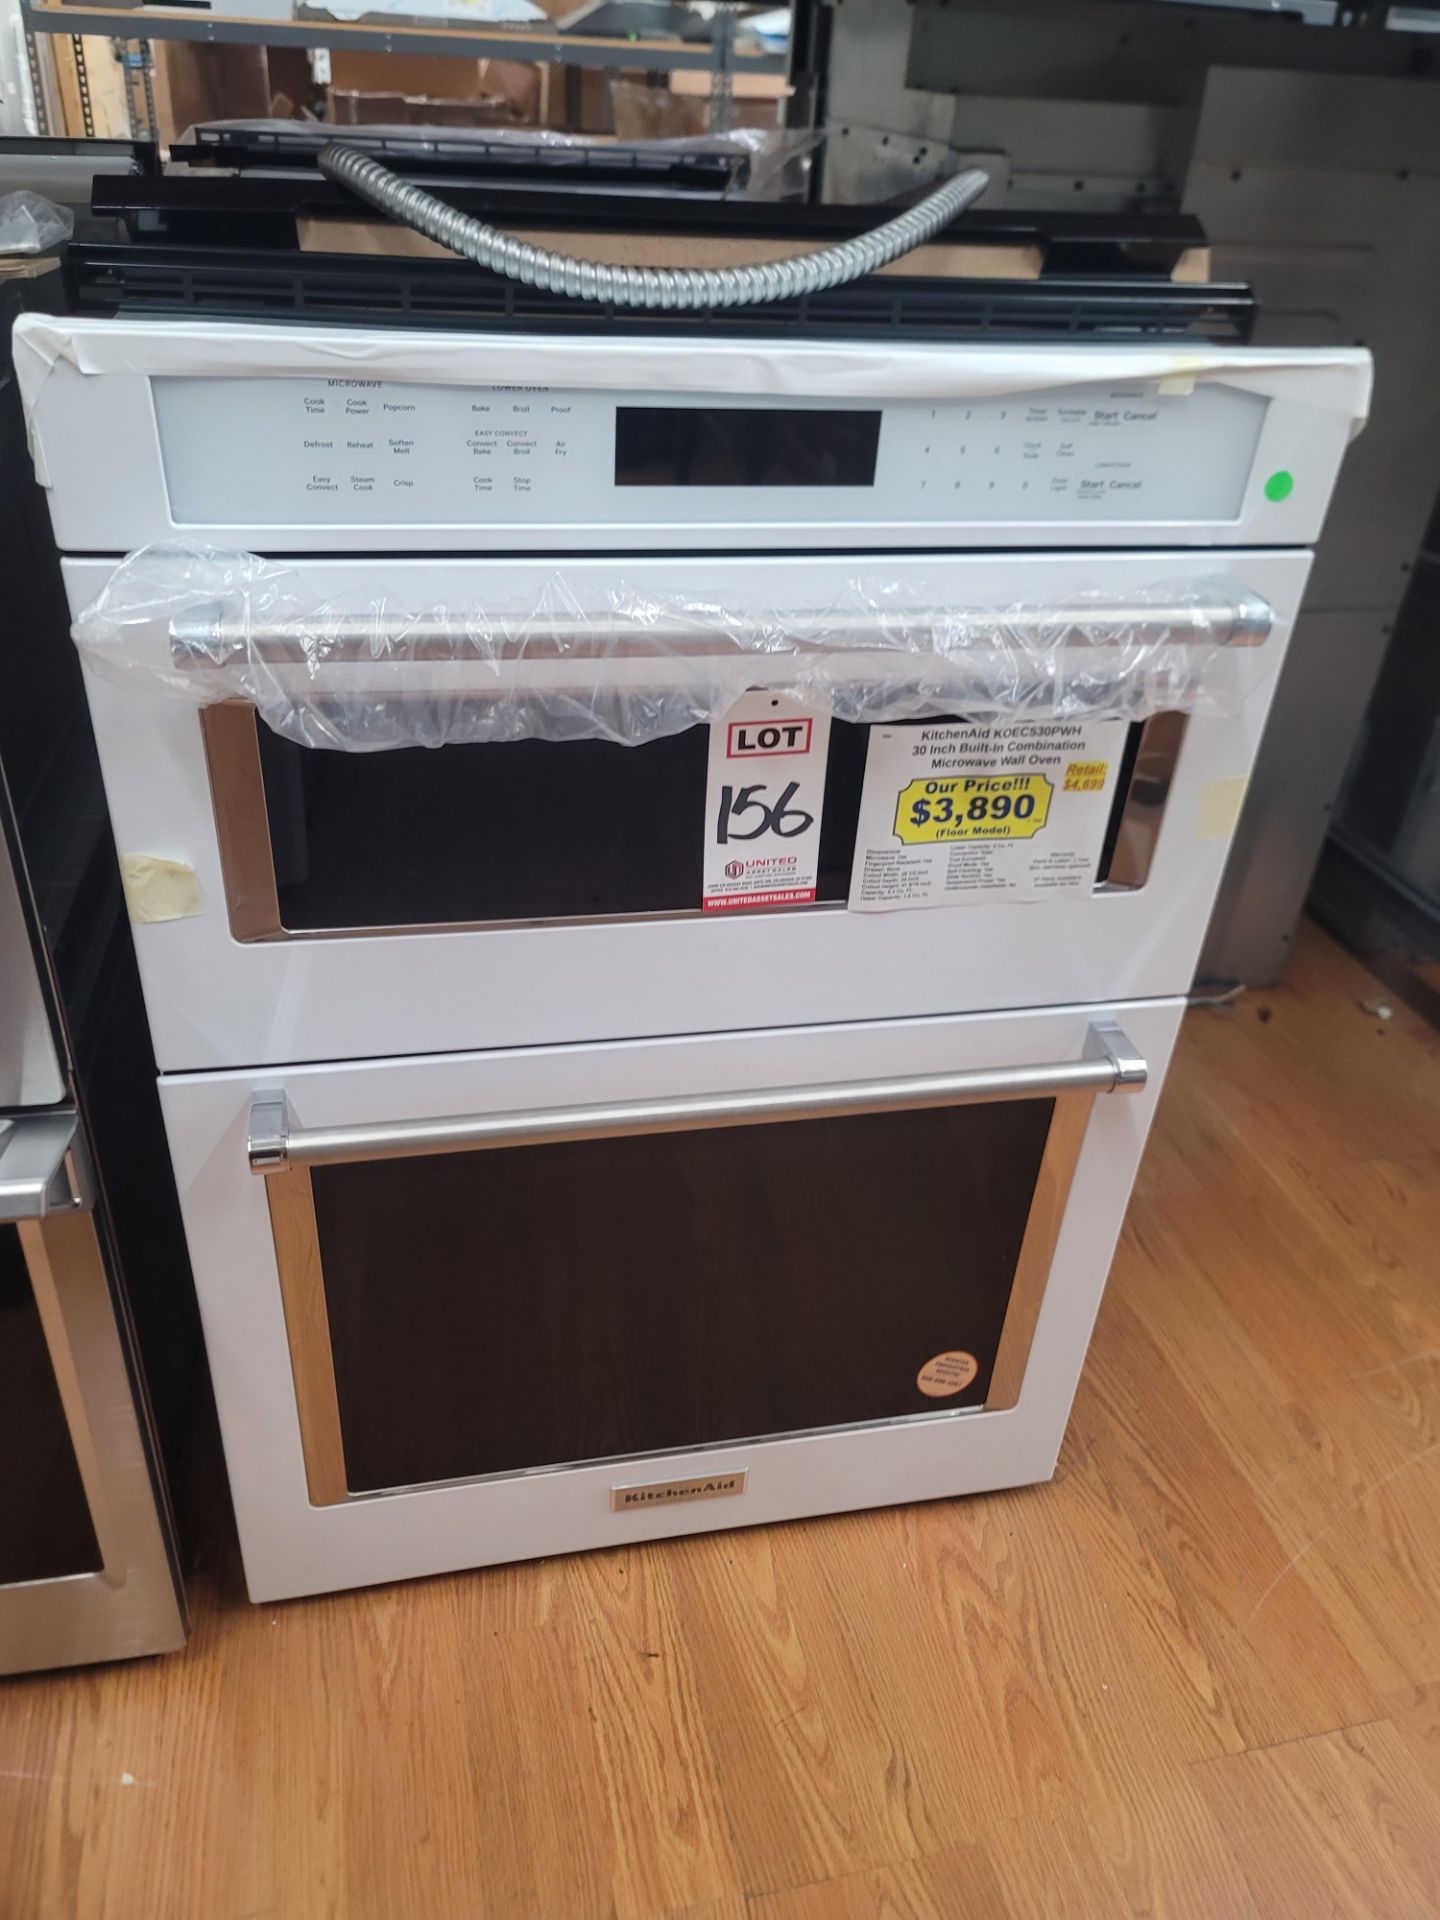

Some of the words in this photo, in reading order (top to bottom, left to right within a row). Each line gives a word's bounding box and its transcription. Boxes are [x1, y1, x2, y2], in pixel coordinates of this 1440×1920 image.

[328, 379, 383, 389] MICROWAVE
[304, 397, 325, 405] Cook
[347, 399, 367, 407] Cook
[306, 406, 325, 414] Time
[345, 407, 370, 415] Power
[383, 403, 415, 412] Popcorn
[513, 405, 530, 413] Broil
[551, 406, 571, 414] Proof
[1094, 410, 1118, 420] Start
[1123, 410, 1157, 421] Cancel
[304, 440, 333, 448] Defrost
[347, 441, 374, 449] Reheat
[388, 439, 414, 447] Soften
[466, 440, 497, 448] Convect
[506, 440, 537, 448] Convect
[393, 447, 410, 455] Melt
[313, 476, 331, 484] Easy
[393, 479, 414, 488] Crisp
[513, 477, 530, 485] Stop
[306, 483, 338, 491] Convect
[1080, 480, 1104, 489] Start
[1109, 480, 1142, 489] Cancel
[921, 729, 990, 742] KitchenAid
[993, 726, 1082, 740] KOEC530PWH
[737, 726, 803, 751] LOT
[912, 745, 927, 756] 30
[930, 742, 956, 755] Inch
[959, 741, 1004, 754] Built-In
[1007, 740, 1086, 752] Combination
[931, 757, 997, 769] Microwave
[1000, 755, 1026, 767] Wall
[1028, 755, 1061, 766] Oven
[925, 781, 958, 795] Our
[963, 777, 1030, 793] Price!!!
[717, 781, 814, 844] 156
[910, 794, 1035, 828] $3,890
[936, 827, 969, 839] (Floor
[972, 826, 1011, 837] Model)
[746, 857, 797, 867] UNITED
[625, 1480, 735, 1503] KitchenAid
